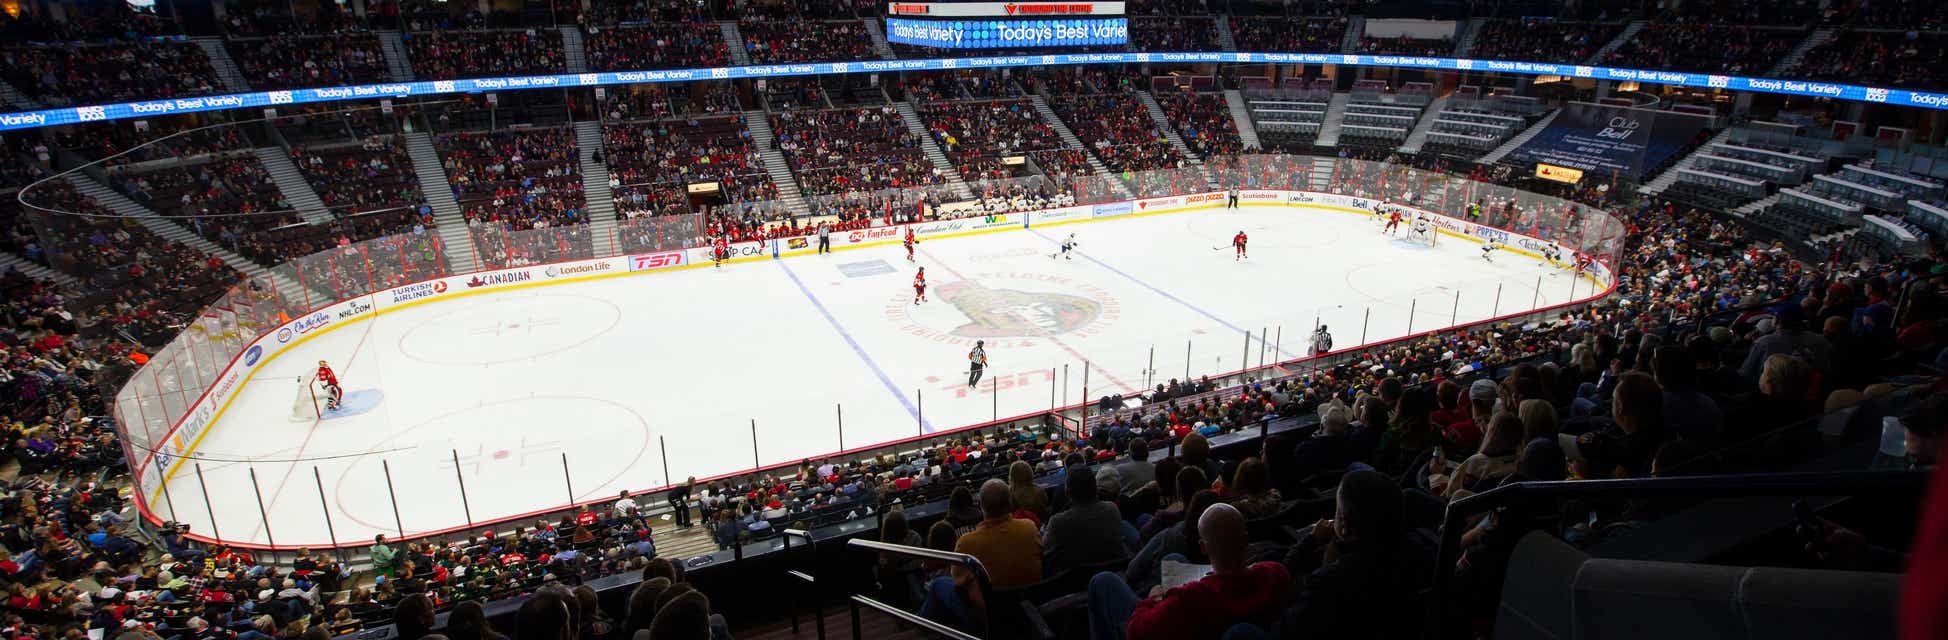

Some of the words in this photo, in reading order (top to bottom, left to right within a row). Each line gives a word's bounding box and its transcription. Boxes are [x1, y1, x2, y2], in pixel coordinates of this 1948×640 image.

[894, 23, 914, 40] Today's
[915, 25, 928, 39] Best
[928, 25, 963, 46] Variety
[997, 25, 1052, 43] Today's
[1057, 24, 1088, 39] Best
[970, 58, 992, 66] Today's
[993, 57, 1007, 65] Best
[1008, 57, 1028, 65] Variety
[1068, 55, 1089, 63] Today's
[1103, 54, 1123, 62] Variety
[1163, 53, 1185, 61] Today's
[1185, 53, 1200, 61] Best
[1200, 54, 1221, 62] Variety
[1264, 54, 1287, 62] Today's
[1289, 54, 1306, 62] Best
[1307, 55, 1328, 64] Variety
[1374, 56, 1397, 66] Today's
[1399, 57, 1416, 66] Best
[1417, 57, 1440, 67] Variety
[745, 67, 772, 75] Today's
[790, 65, 814, 74] Variety
[863, 61, 888, 70] Today's
[888, 61, 904, 69] Best
[904, 60, 926, 69] Variety
[1488, 61, 1514, 70] Today's
[1516, 62, 1534, 71] Best
[1535, 63, 1558, 73] Variety
[473, 78, 507, 88] Today's
[509, 76, 529, 86] Best
[531, 76, 558, 86] Variety
[616, 72, 645, 81] Today's
[647, 71, 664, 80] Best
[665, 70, 692, 79] Variety
[1609, 69, 1636, 79] Today's
[1638, 71, 1657, 80] Best
[1658, 72, 1687, 82] Variety
[316, 88, 352, 99] Today's
[354, 86, 376, 96] Best
[377, 84, 411, 94] Variety
[1748, 79, 1782, 90] Today's
[1785, 81, 1806, 91] Best
[1808, 83, 1842, 95] Variety
[132, 100, 174, 113] Today's
[178, 98, 203, 110] Best
[205, 96, 243, 108] Variety
[1910, 93, 1948, 105] Today's
[1, 113, 45, 126] Variety
[1609, 116, 1639, 129] Club
[1596, 127, 1633, 139] Bell
[1186, 195, 1205, 205] pizza
[1206, 193, 1225, 203] pizza
[1353, 198, 1368, 209] Bell
[1432, 215, 1459, 232] Hortons
[560, 264, 594, 275] London
[595, 261, 611, 271] Life
[634, 254, 682, 269] TSN
[484, 271, 530, 286] CANADIAN
[391, 282, 432, 297] TURKISH
[393, 289, 434, 304] AIRLINES
[339, 305, 371, 320] NHL.COM
[294, 321, 305, 333] On
[305, 317, 315, 328] the
[315, 312, 330, 325] Run
[944, 368, 1054, 399] TSN
[180, 406, 210, 444] Mark's
[157, 445, 171, 471] Bell
